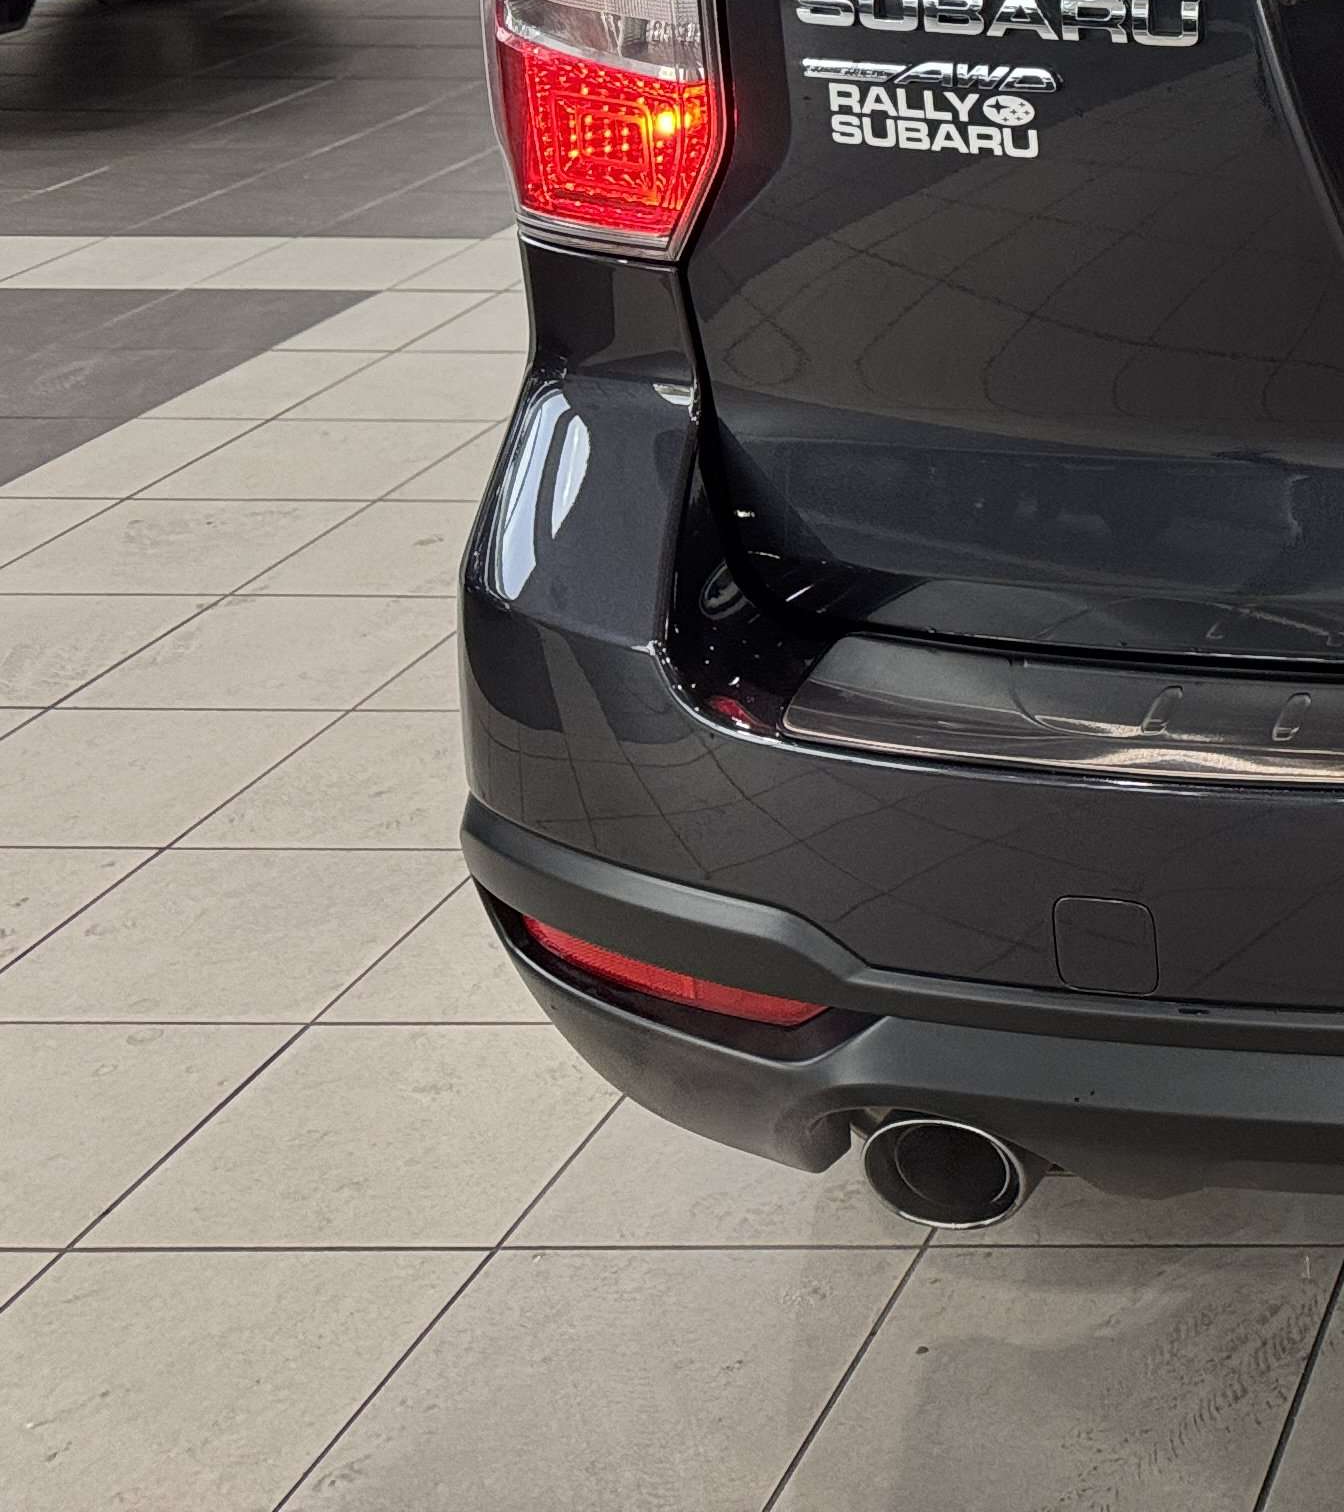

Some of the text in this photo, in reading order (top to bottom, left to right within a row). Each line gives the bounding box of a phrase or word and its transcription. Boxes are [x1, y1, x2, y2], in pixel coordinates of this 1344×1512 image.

[893, 61, 1058, 93] AWD
[828, 82, 980, 123] RALLY
[831, 114, 1040, 159] SUBARU
